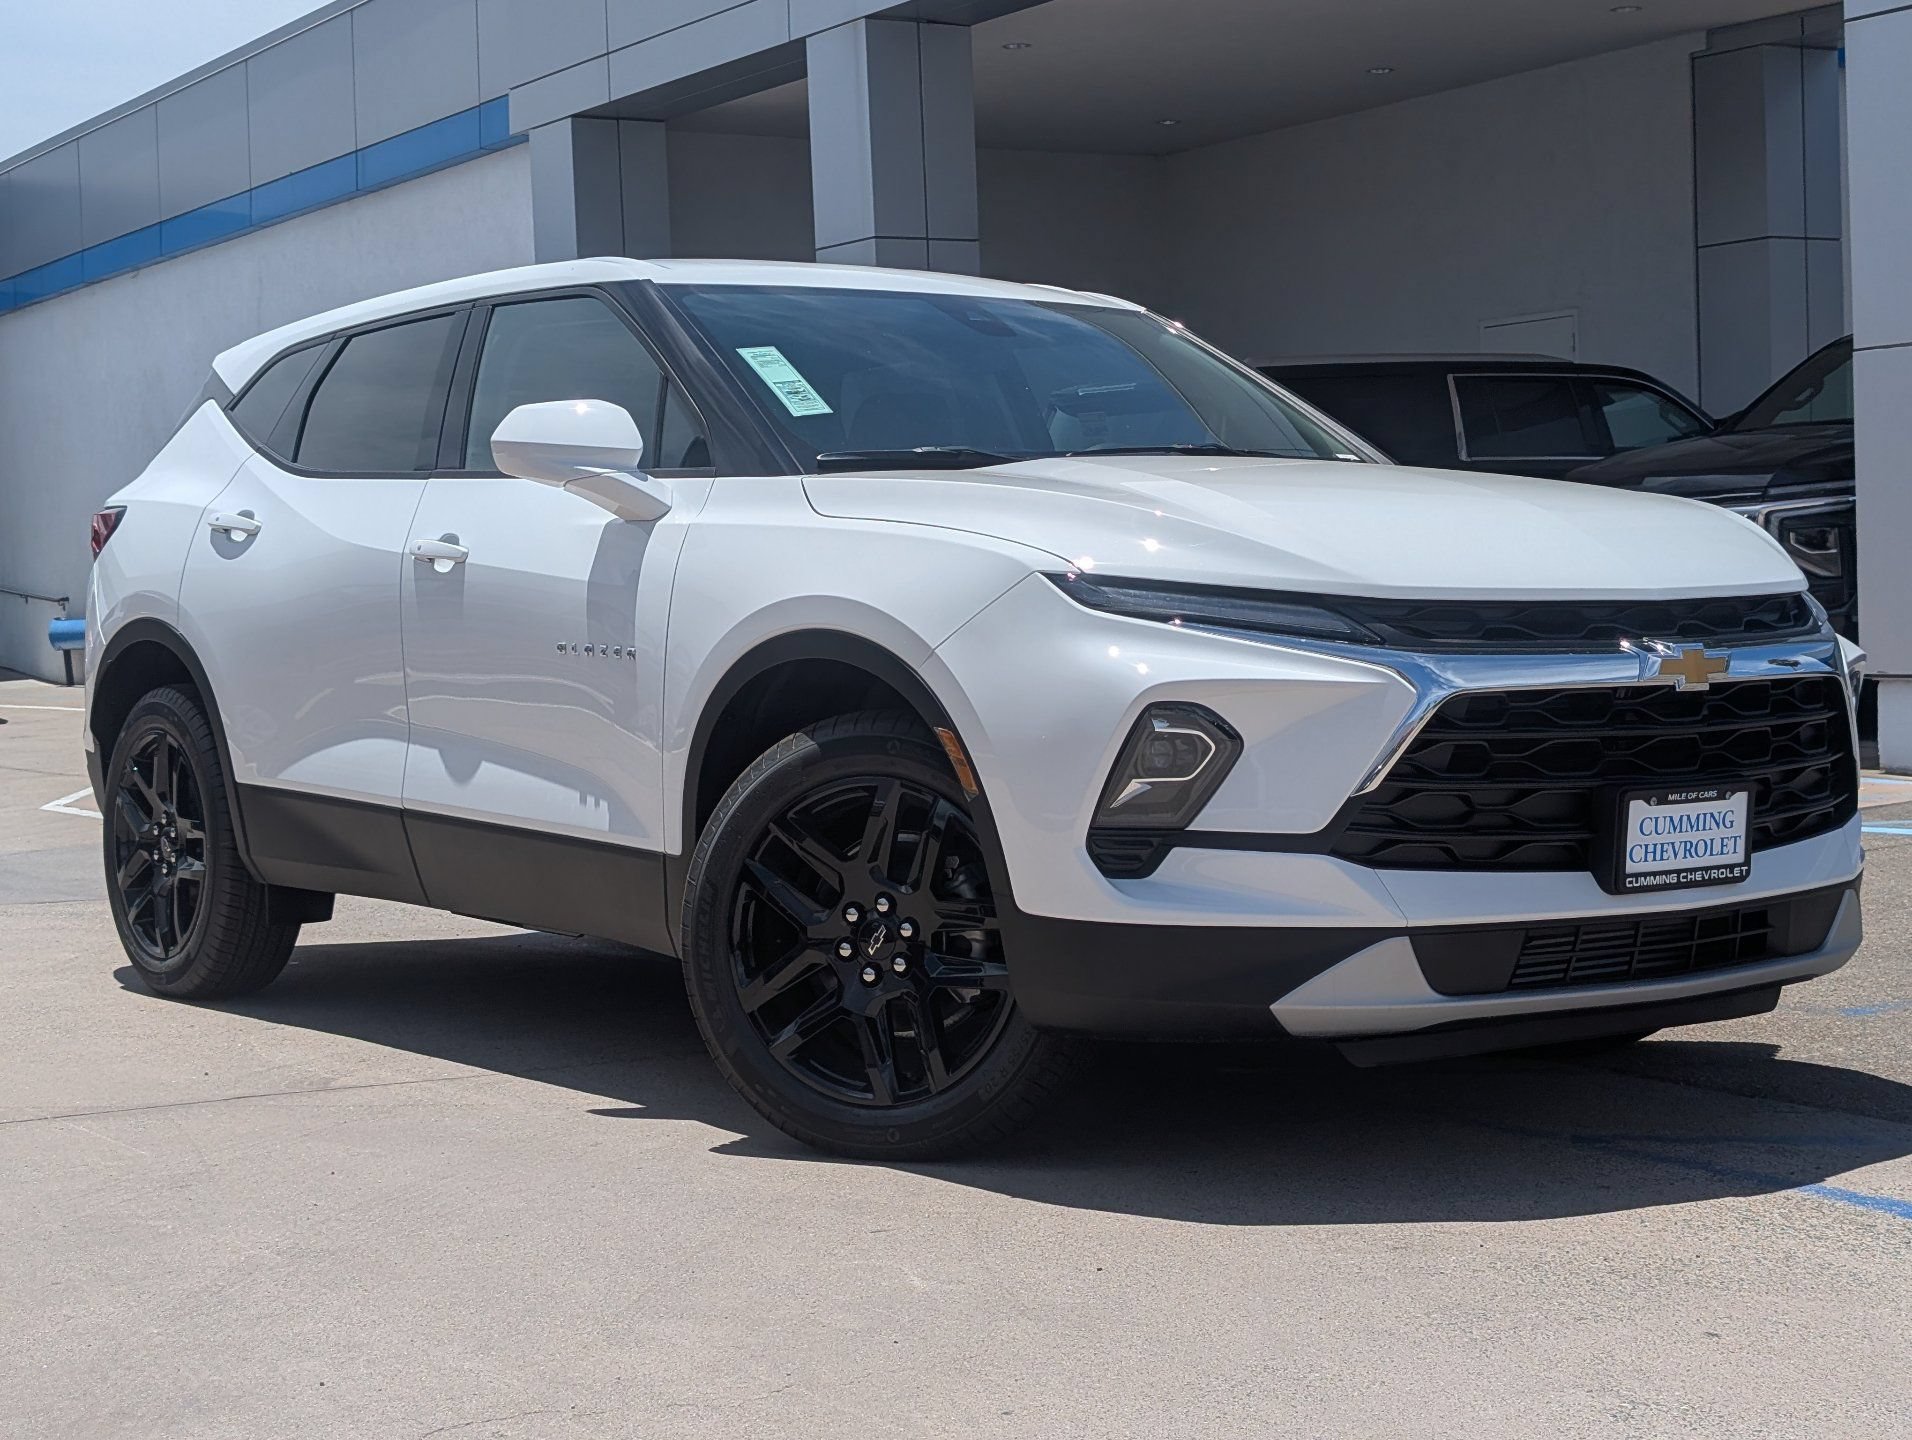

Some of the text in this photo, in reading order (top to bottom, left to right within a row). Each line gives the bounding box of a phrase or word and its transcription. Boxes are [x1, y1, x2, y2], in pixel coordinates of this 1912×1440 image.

[557, 642, 636, 659] BLAZER
[1667, 790, 1718, 801] MILE OF CARS
[1639, 810, 1735, 836] CUMMING
[1629, 836, 1741, 863] CHEVROLET
[1626, 867, 1748, 887] CUMMING CHEVROLET
